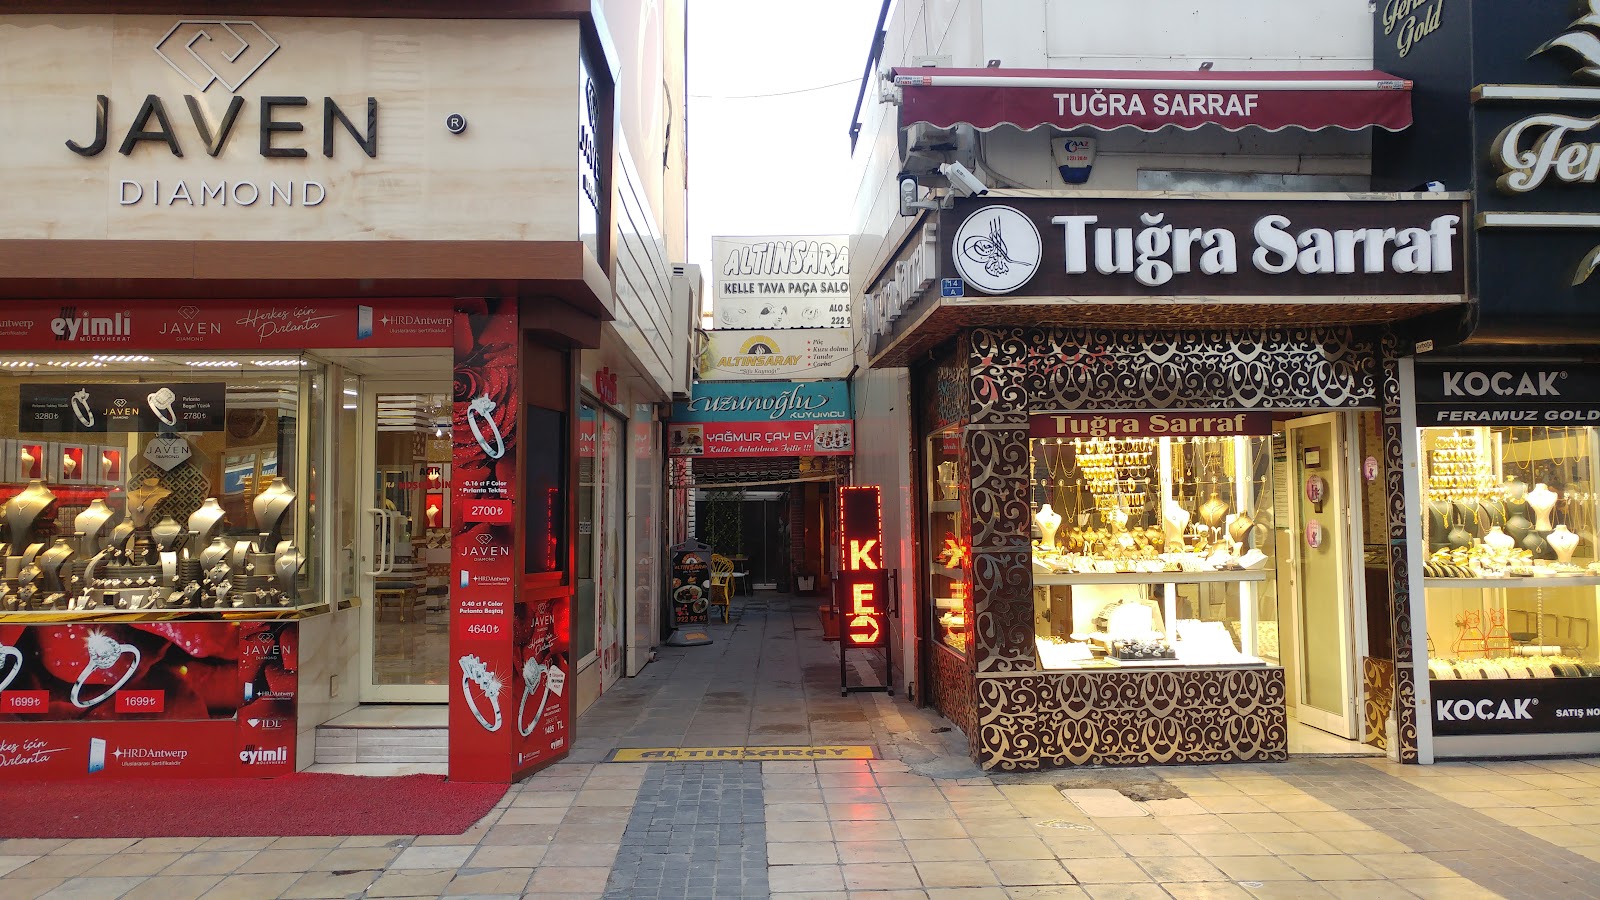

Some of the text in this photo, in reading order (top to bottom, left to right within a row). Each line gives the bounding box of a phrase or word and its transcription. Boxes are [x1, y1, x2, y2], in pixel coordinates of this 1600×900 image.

[1397, 0, 1443, 58] Gold
[1053, 88, 1259, 116] TUĞRA SARRAF
[65, 94, 378, 158] JAVEN
[119, 179, 326, 207] DIAMOND
[1051, 211, 1239, 288] Tuğra
[1251, 213, 1461, 276] Sarraf
[723, 282, 755, 294] KELLE
[757, 282, 786, 294] TAVA
[788, 281, 818, 297] PAÇA
[828, 303, 844, 313] ALO
[236, 306, 317, 328] Herkes için
[830, 316, 845, 325] 222
[50, 310, 131, 341] eyimli
[159, 322, 222, 335] JAVEN
[716, 354, 803, 367] ALTINSARAY
[103, 407, 140, 416] JAVEN
[789, 410, 845, 419] KUYUMCU
[1436, 410, 1600, 421] FERAMUZ GOLD
[1050, 413, 1247, 437] Tuğra Sarraf
[706, 430, 761, 442] YAĞMUR
[764, 431, 791, 444] ÇAY
[794, 431, 814, 441] EVİ
[147, 446, 189, 454] JAVEN
[488, 487, 508, 495] Tektaş
[461, 546, 509, 556] JAVEN
[484, 607, 504, 615] Beştaş
[530, 614, 555, 628] JAVEN
[243, 645, 291, 655] JAVEN
[1555, 708, 1585, 719] SATIŞ
[261, 719, 283, 728] IDL
[23, 738, 48, 752] için
[239, 746, 288, 764] eyimli
[641, 748, 849, 759] ALTINSARAY
